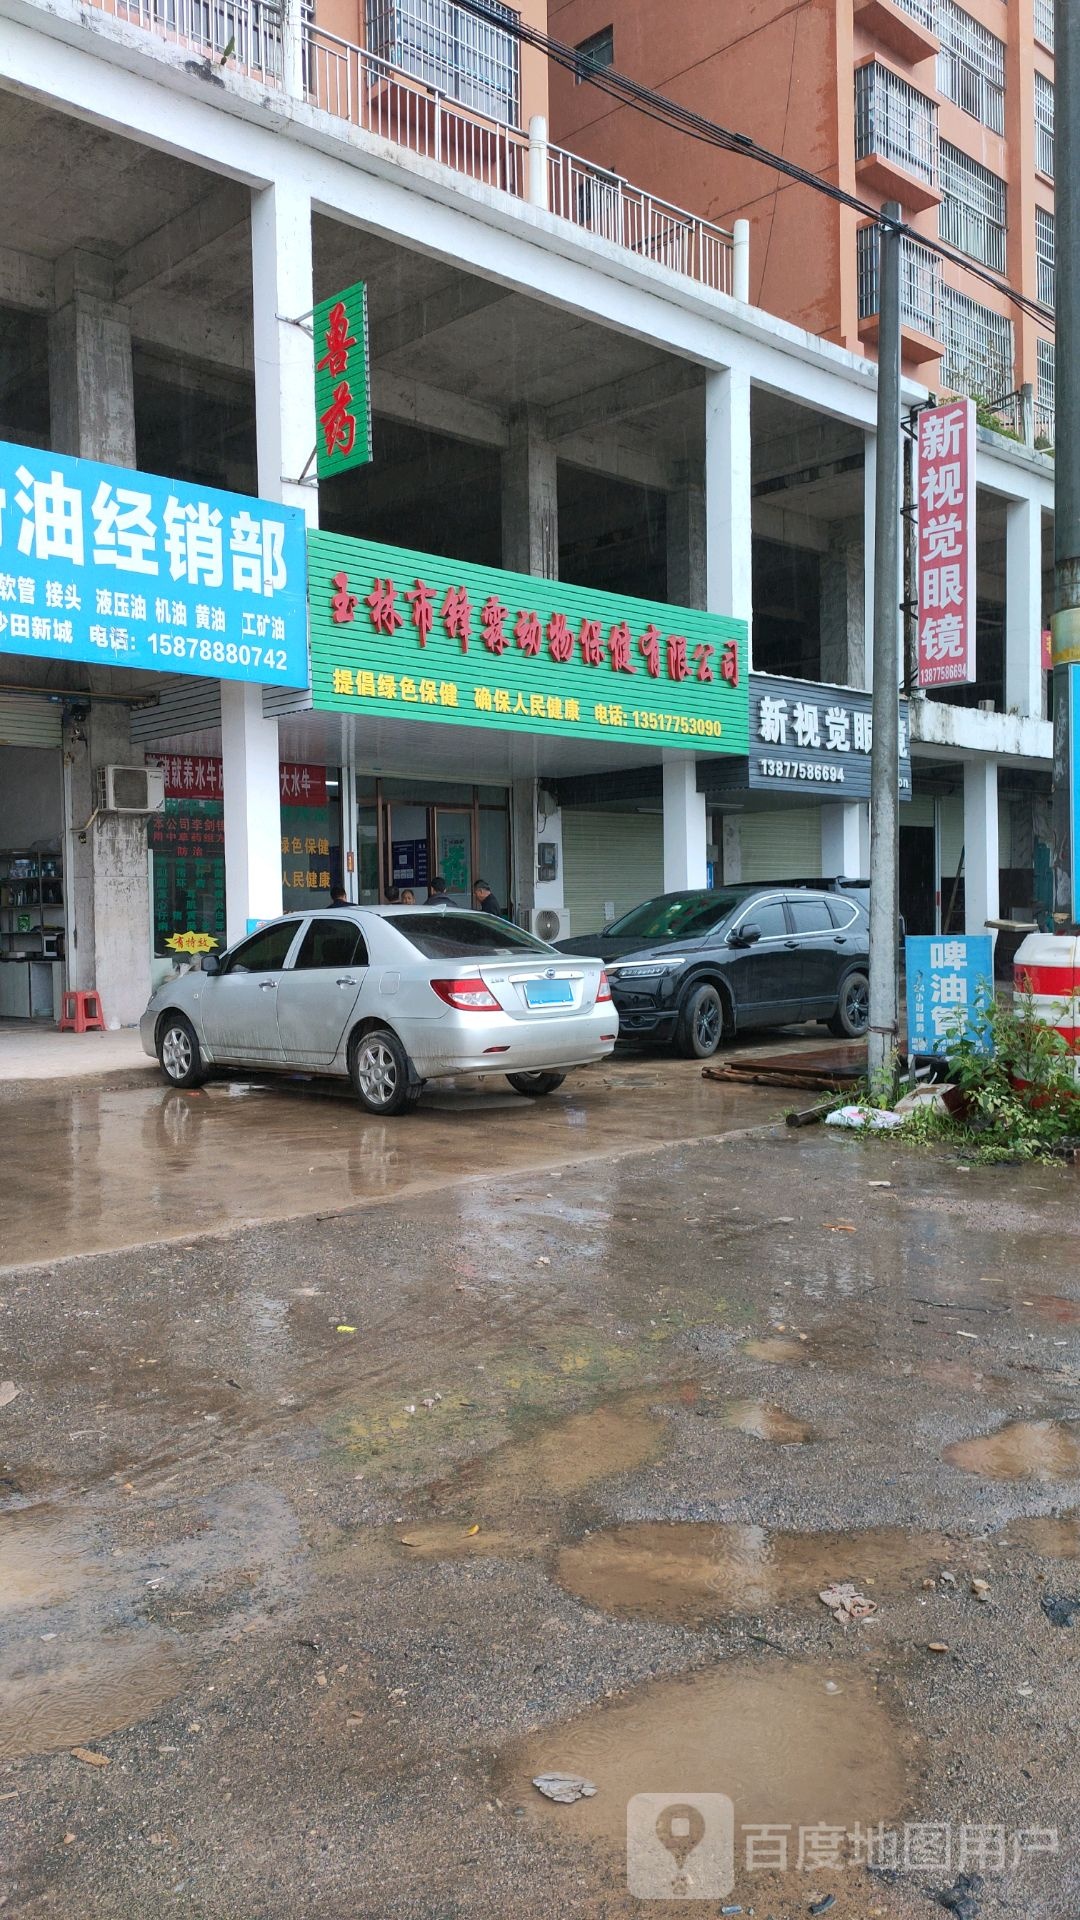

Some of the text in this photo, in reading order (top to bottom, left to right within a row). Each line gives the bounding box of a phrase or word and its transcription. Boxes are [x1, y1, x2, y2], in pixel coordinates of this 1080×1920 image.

[316, 301, 357, 457] 兽药
[0, 465, 288, 598] 油经销部
[921, 408, 965, 660] 新视觉眼镜
[45, 579, 82, 612] 接头
[95, 588, 147, 621] 液压油
[155, 597, 187, 627] 机油
[195, 604, 226, 633] 黄油
[242, 612, 285, 641] 工矿油
[332, 668, 458, 707] 提倡绿色保健
[474, 687, 580, 722] 确保人民健康
[920, 663, 967, 684] 13877586694
[280, 765, 311, 798] 大水牛
[759, 758, 845, 782] 13877586694
[281, 871, 331, 888] 人民健康
[930, 941, 968, 1036] 啤油管
